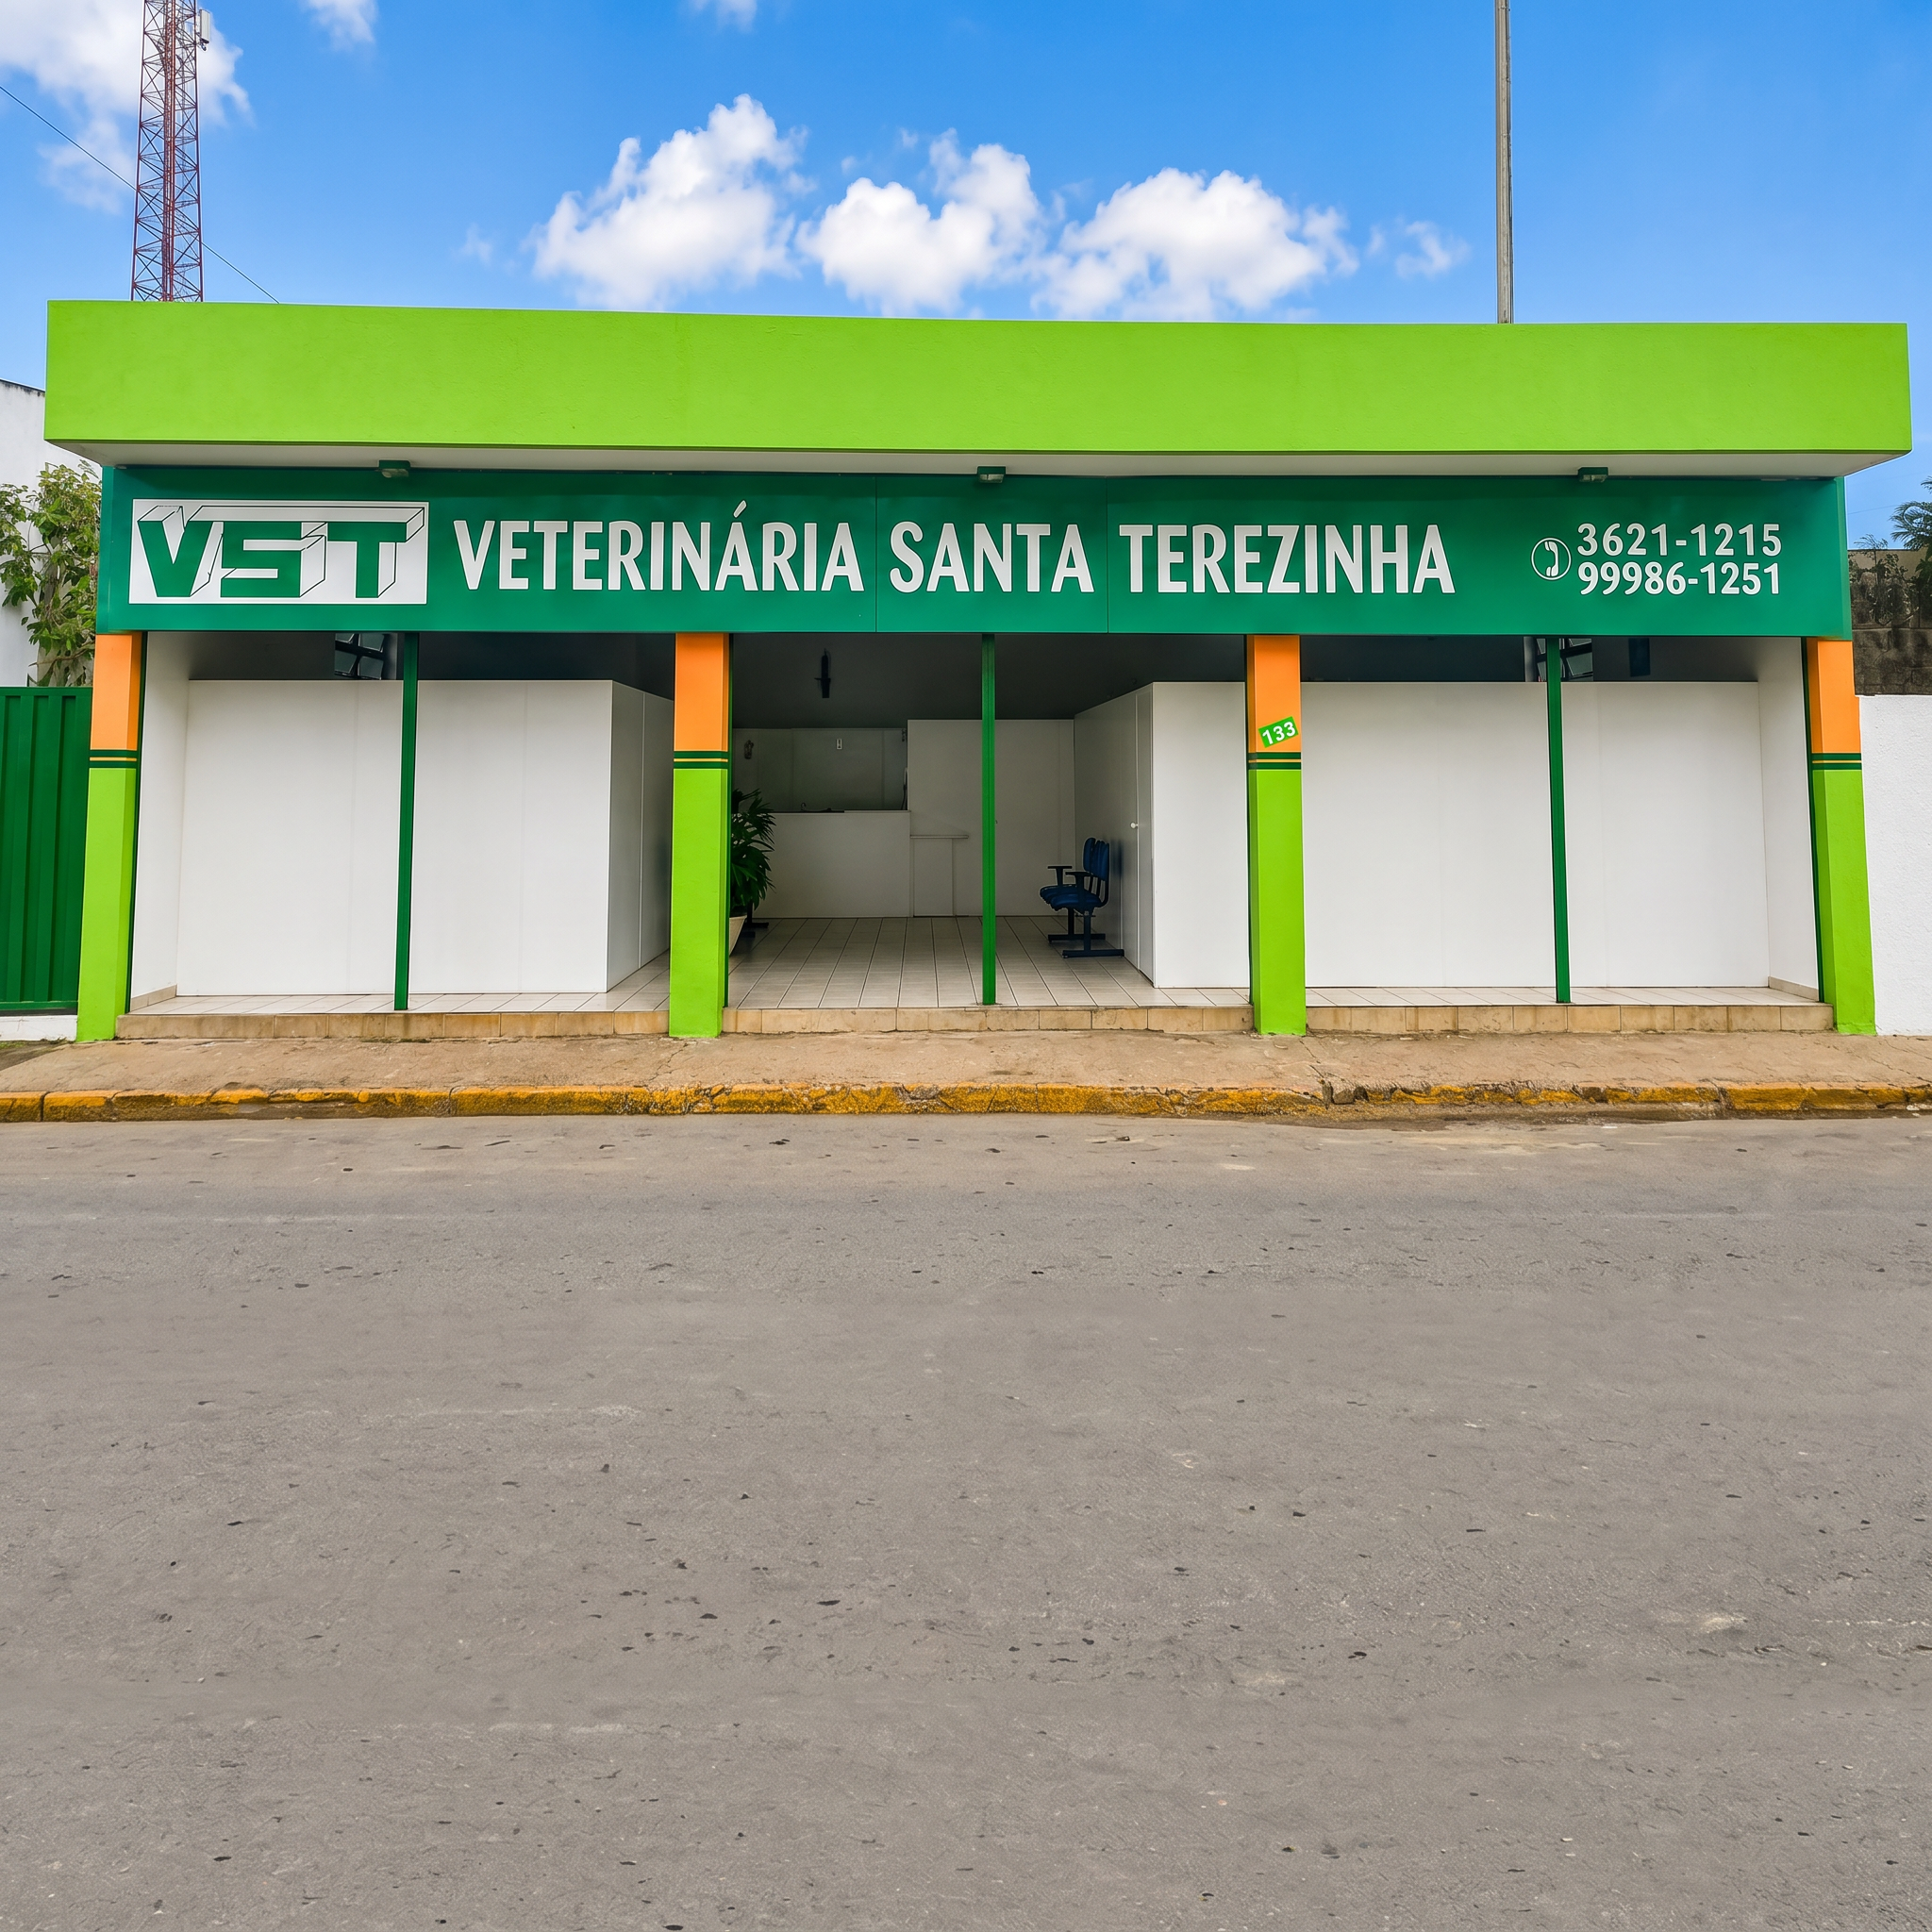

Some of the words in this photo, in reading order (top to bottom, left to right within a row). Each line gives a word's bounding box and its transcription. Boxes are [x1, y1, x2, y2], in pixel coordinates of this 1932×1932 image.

[453, 500, 865, 591] VETERINÁRIA
[890, 521, 1095, 593] SANTA
[1119, 524, 1456, 594] TEREZINHA
[1577, 523, 1782, 557] 3621-1215
[1577, 561, 1780, 595] 99986-1251
[1262, 721, 1296, 745] 133
